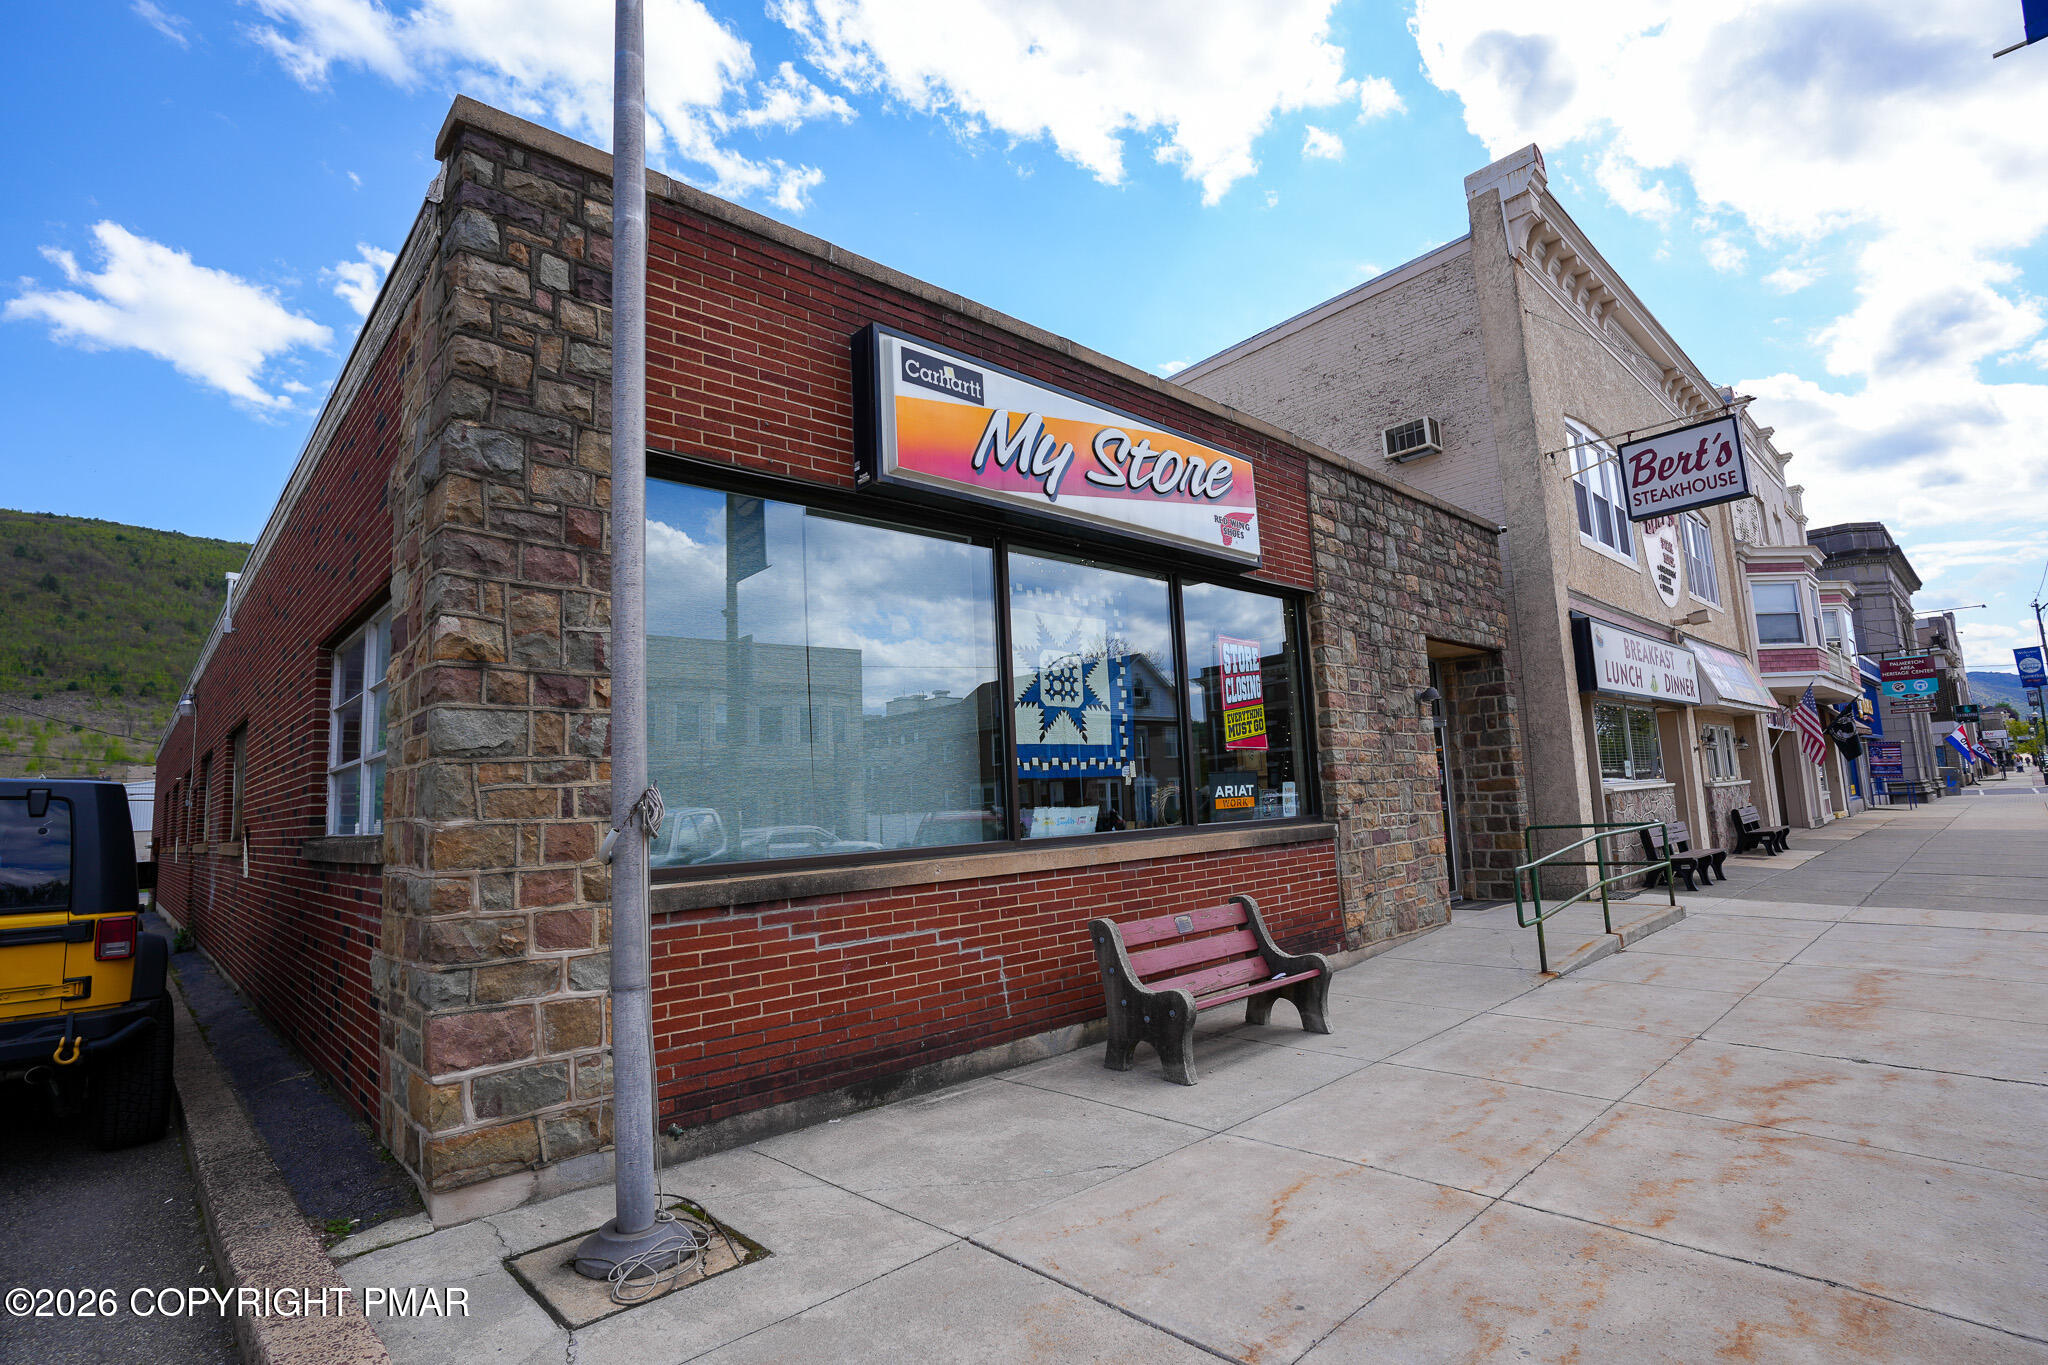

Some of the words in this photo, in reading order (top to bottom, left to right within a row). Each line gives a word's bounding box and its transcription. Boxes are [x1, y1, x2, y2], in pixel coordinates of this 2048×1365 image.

[905, 359, 982, 399] Carhartt
[973, 409, 1074, 499] My
[1086, 428, 1234, 499] Store
[1628, 432, 1733, 489] Bert's
[1633, 470, 1738, 507] STEAKHOUSE
[1214, 514, 1229, 526] RED
[1230, 517, 1251, 532] WING
[1223, 526, 1245, 540] SHOES
[1222, 642, 1260, 675] STORE
[1623, 637, 1675, 671] BREAKFAST
[1225, 674, 1262, 705] CLOSING
[1604, 659, 1644, 689] LUNCH
[1664, 673, 1696, 698] DINNER
[1226, 707, 1263, 724] EVERYTHING
[1228, 720, 1252, 739] MUST
[1253, 718, 1264, 733] GO
[1215, 784, 1254, 798] ARIAT
[1222, 798, 1249, 808] WORK
